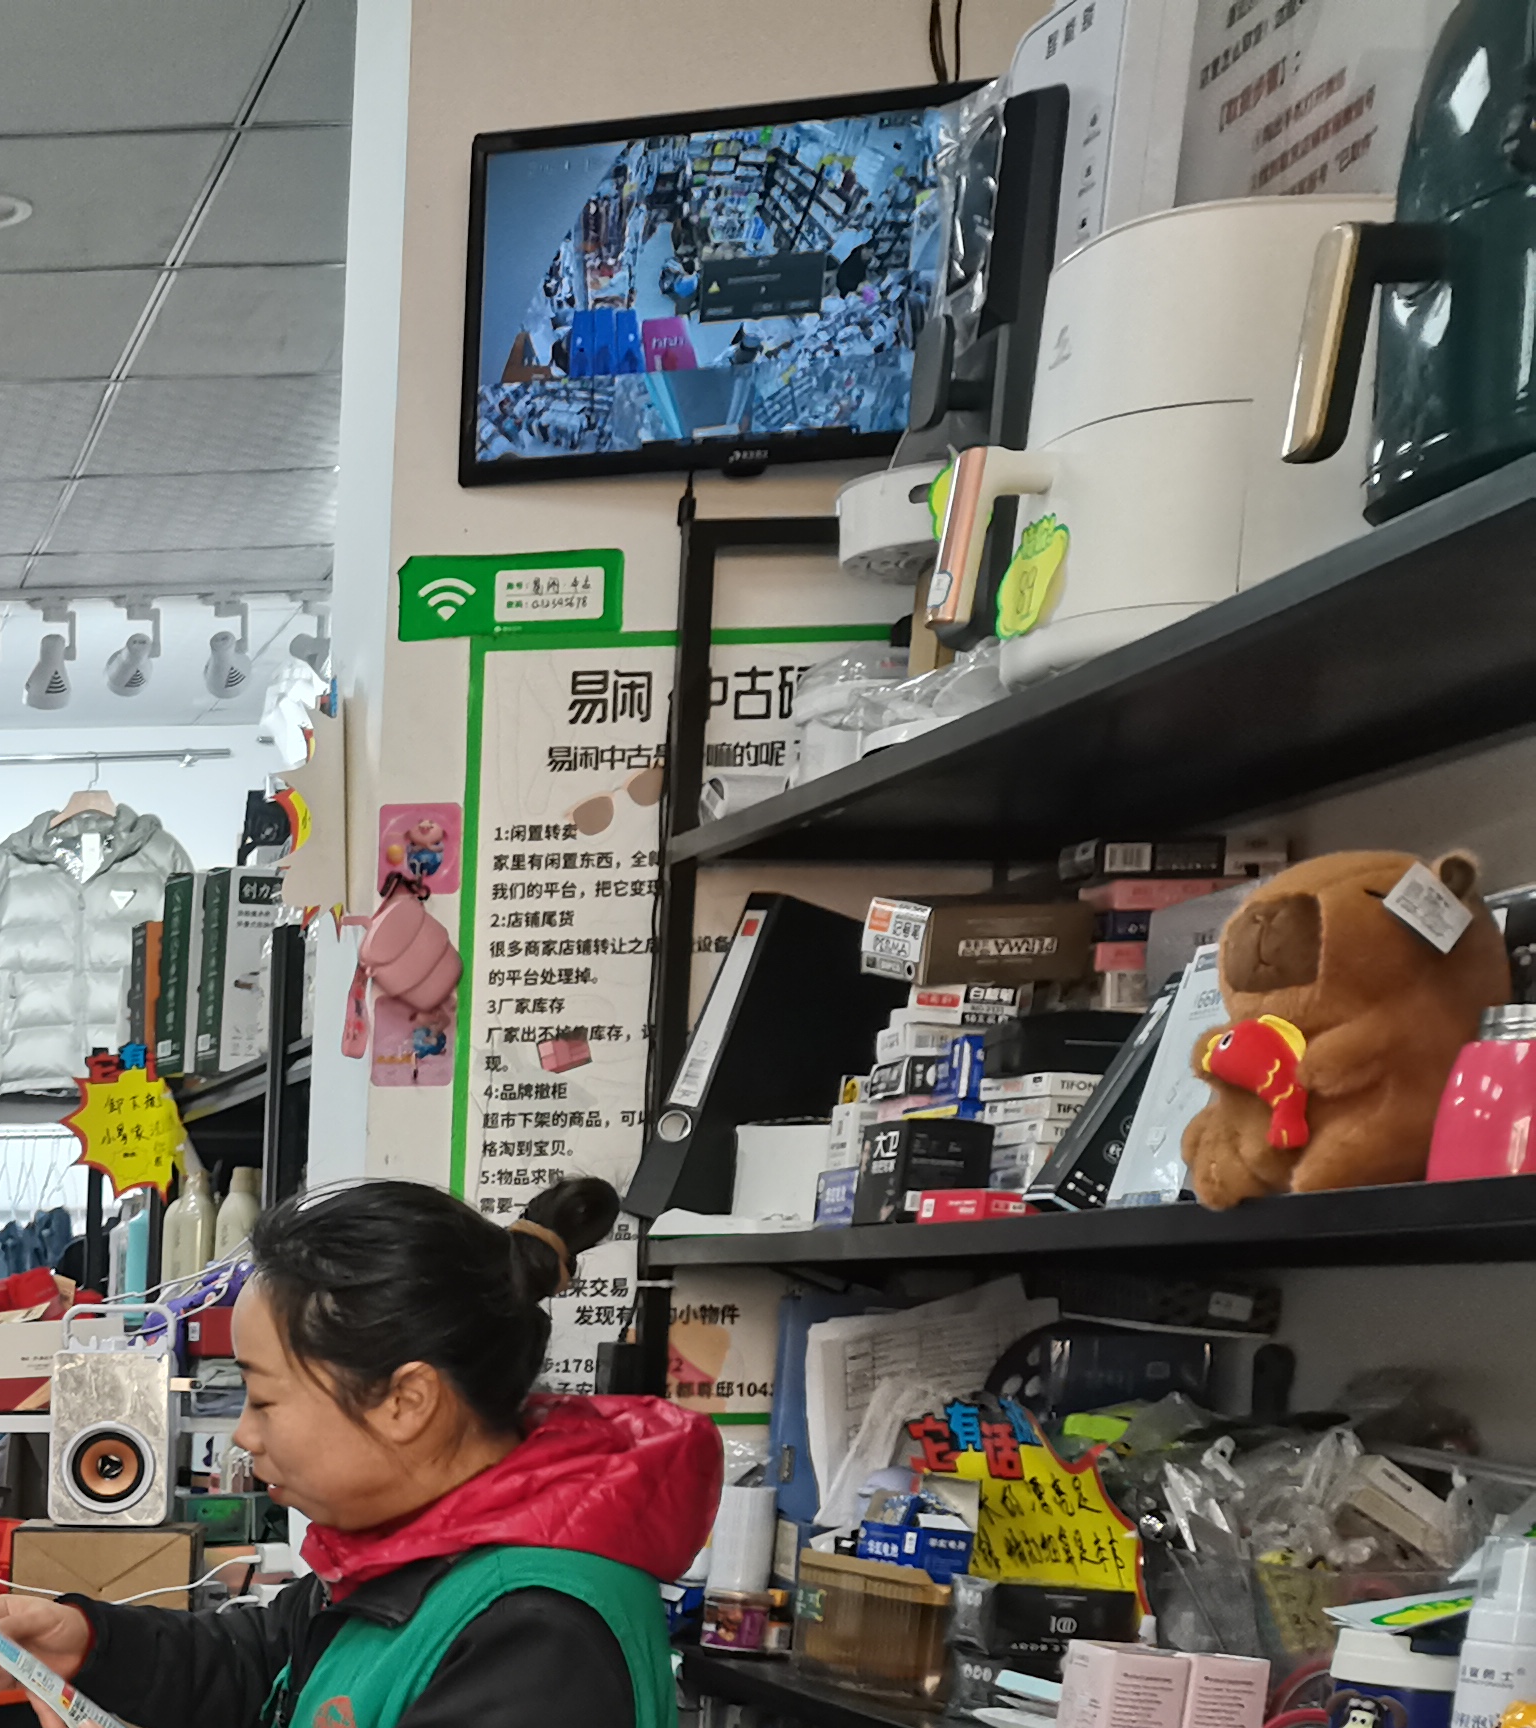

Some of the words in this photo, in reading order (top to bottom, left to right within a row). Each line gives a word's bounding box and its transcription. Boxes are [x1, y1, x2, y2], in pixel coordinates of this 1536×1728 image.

[490, 910, 575, 928] 2:店铺尾货
[488, 968, 599, 986] 的平台处理掉。
[487, 998, 566, 1014] 3厂家库存
[483, 1082, 568, 1100] 4:品牌撤柜
[875, 1130, 900, 1158] 大卫
